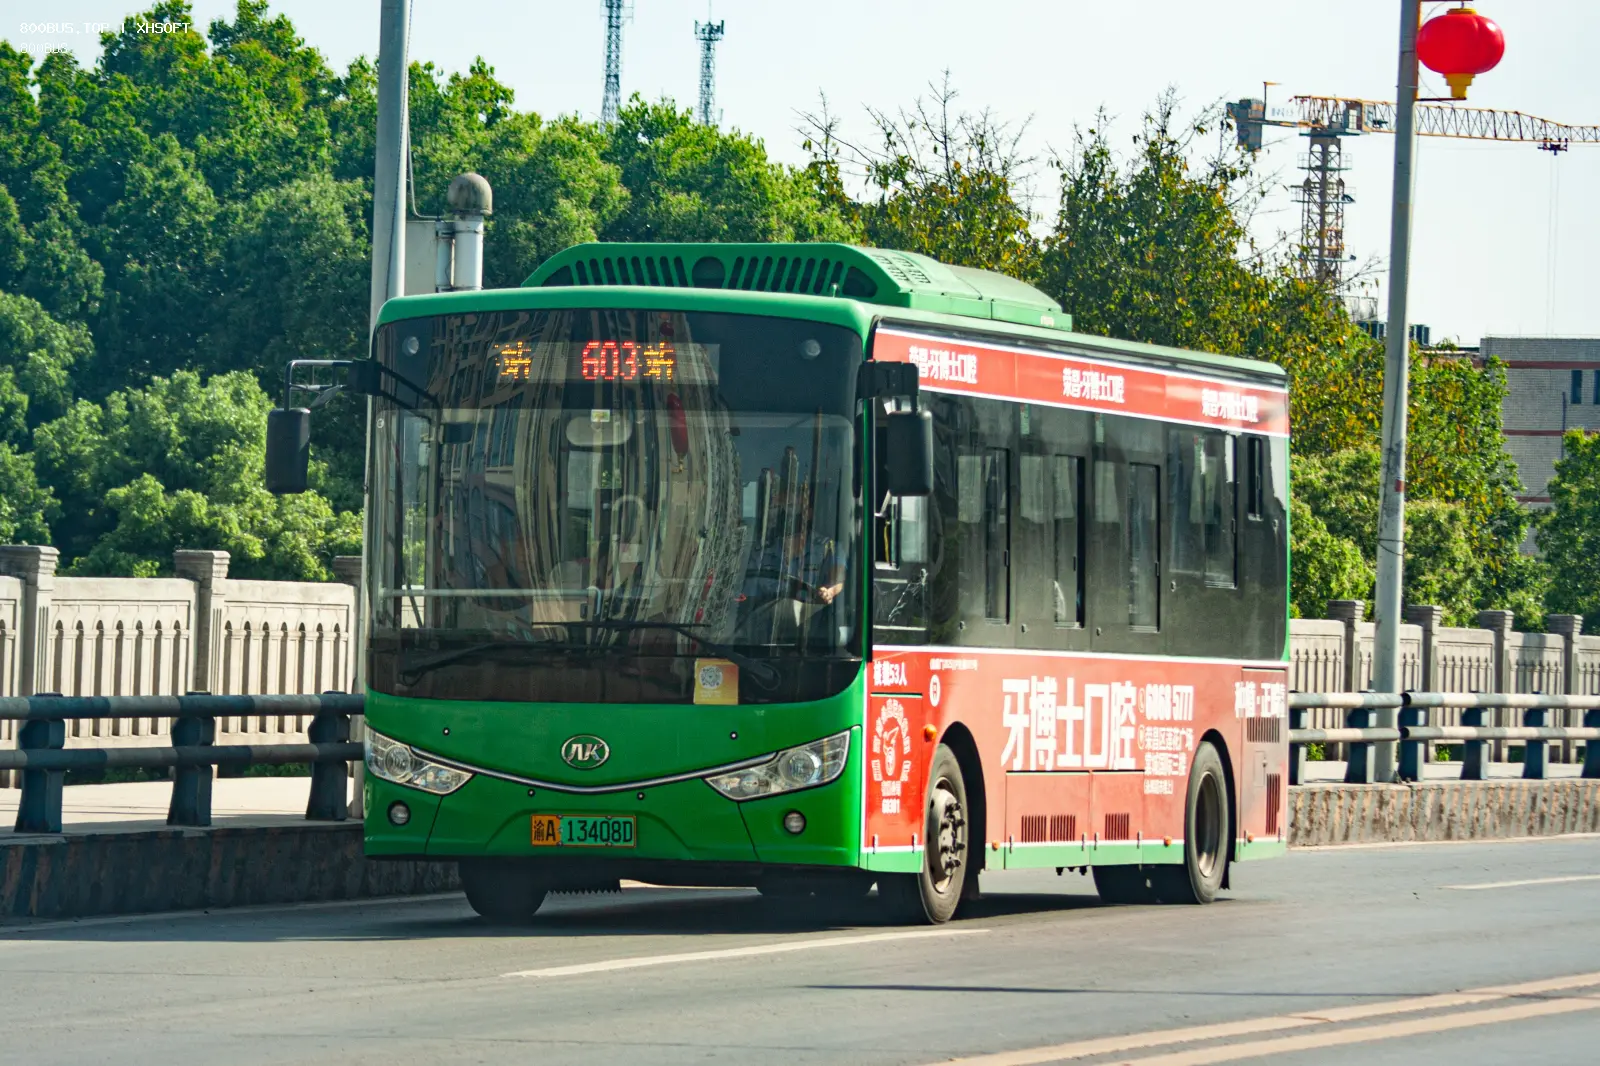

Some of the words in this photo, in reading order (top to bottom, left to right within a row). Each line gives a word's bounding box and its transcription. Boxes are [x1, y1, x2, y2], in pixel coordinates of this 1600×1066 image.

[581, 338, 637, 381] 603
[1000, 675, 1137, 772] 牙博士口腔
